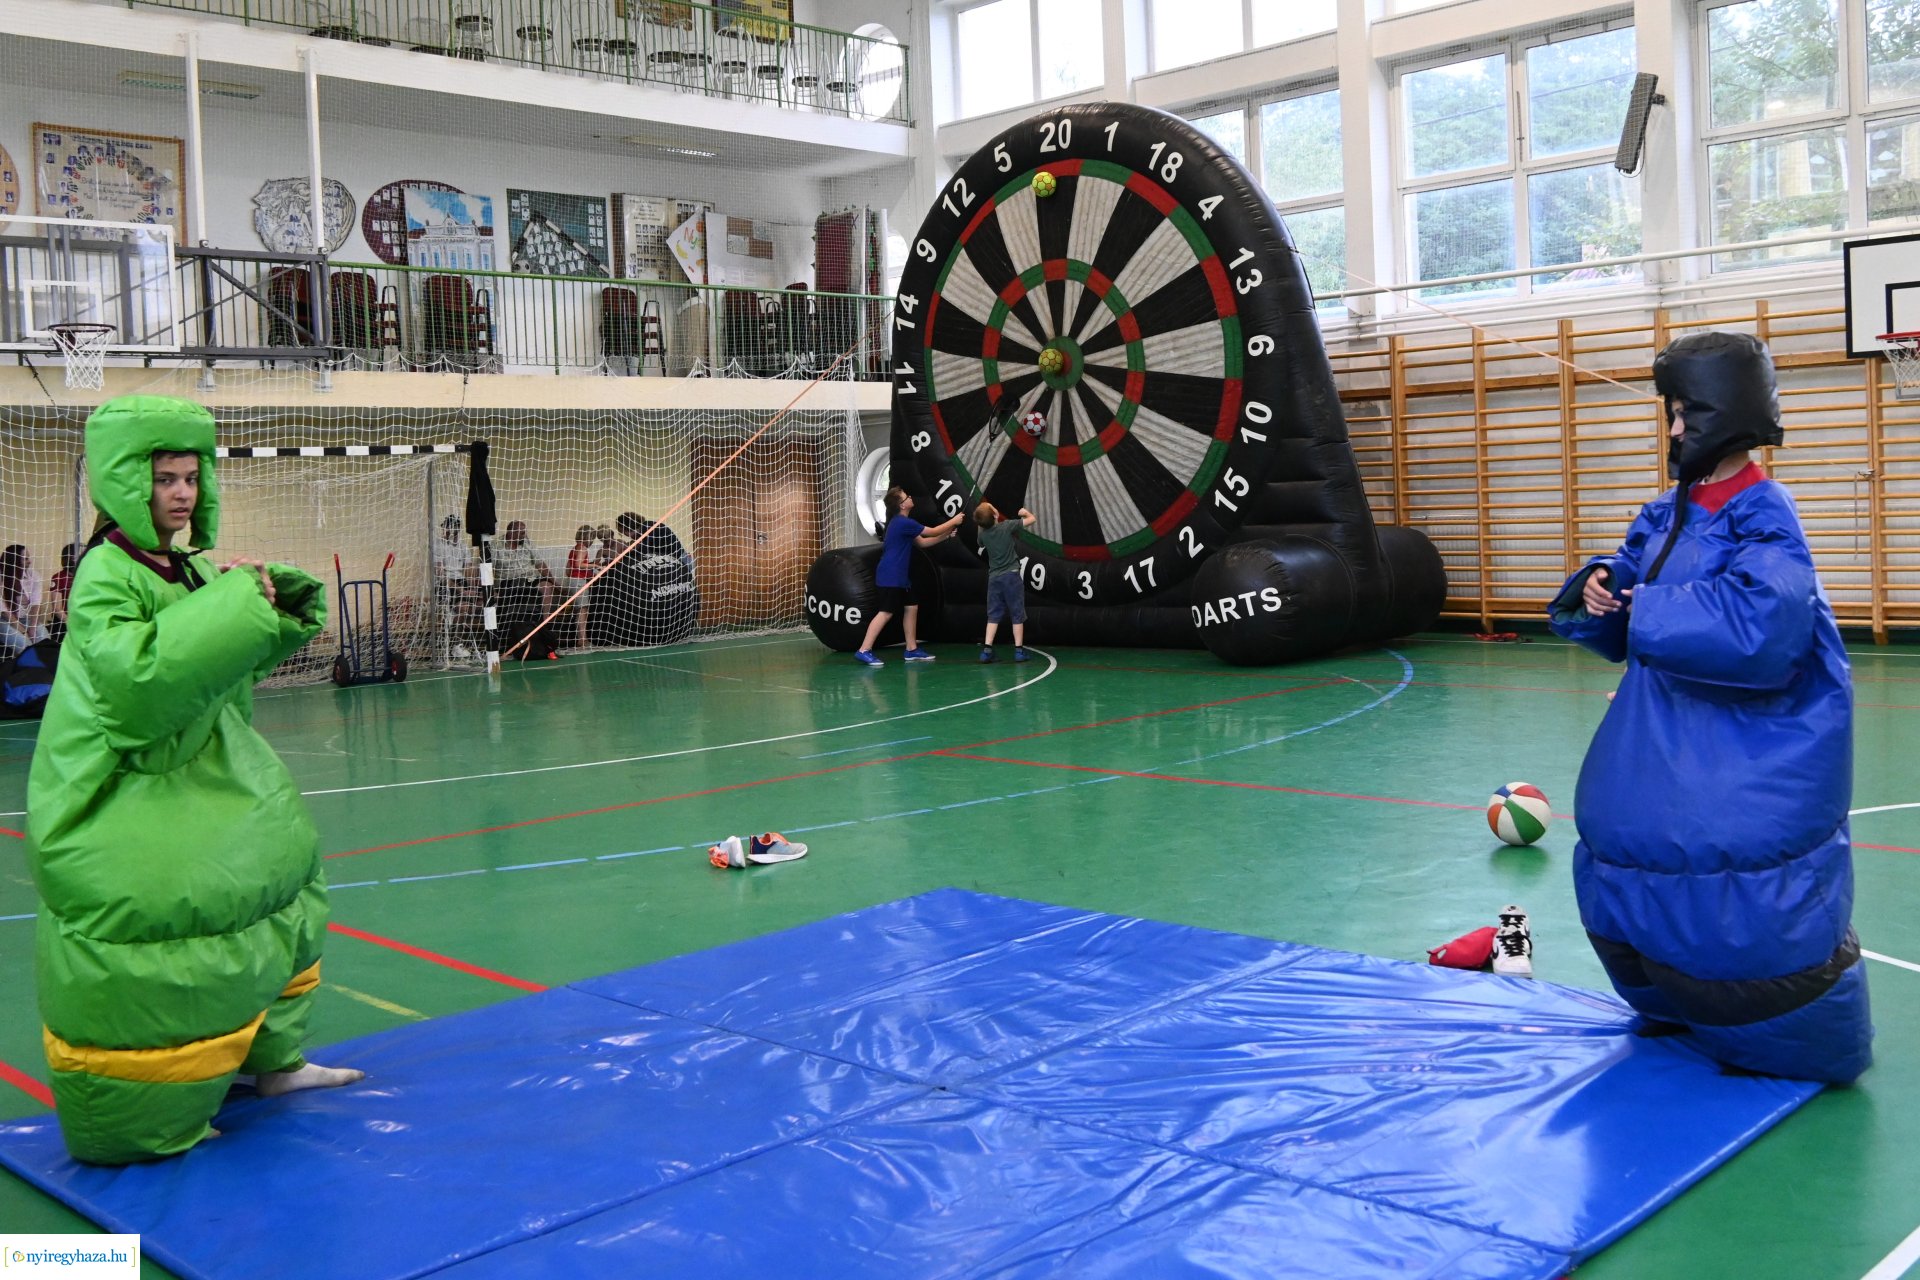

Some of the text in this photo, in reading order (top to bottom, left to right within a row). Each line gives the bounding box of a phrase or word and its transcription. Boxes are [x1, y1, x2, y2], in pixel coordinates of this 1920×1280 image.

[1039, 118, 1072, 153] 20
[1104, 121, 1120, 152] 1
[993, 141, 1012, 173] 5
[1149, 141, 1185, 185] 18
[942, 177, 977, 218] 12
[1197, 194, 1225, 221] 4
[916, 238, 937, 263] 9
[1229, 246, 1263, 296] 13
[895, 293, 919, 332] 14
[1247, 334, 1275, 357] 6
[894, 361, 917, 396] 11
[1240, 401, 1273, 444] 10
[911, 430, 931, 453] 8
[934, 478, 964, 518] 16
[1214, 467, 1250, 513] 15
[1178, 525, 1205, 558] 2
[1019, 556, 1046, 590] 19
[1078, 570, 1094, 600] 3
[1124, 556, 1159, 594] 17
[1191, 587, 1282, 628] DARTS
